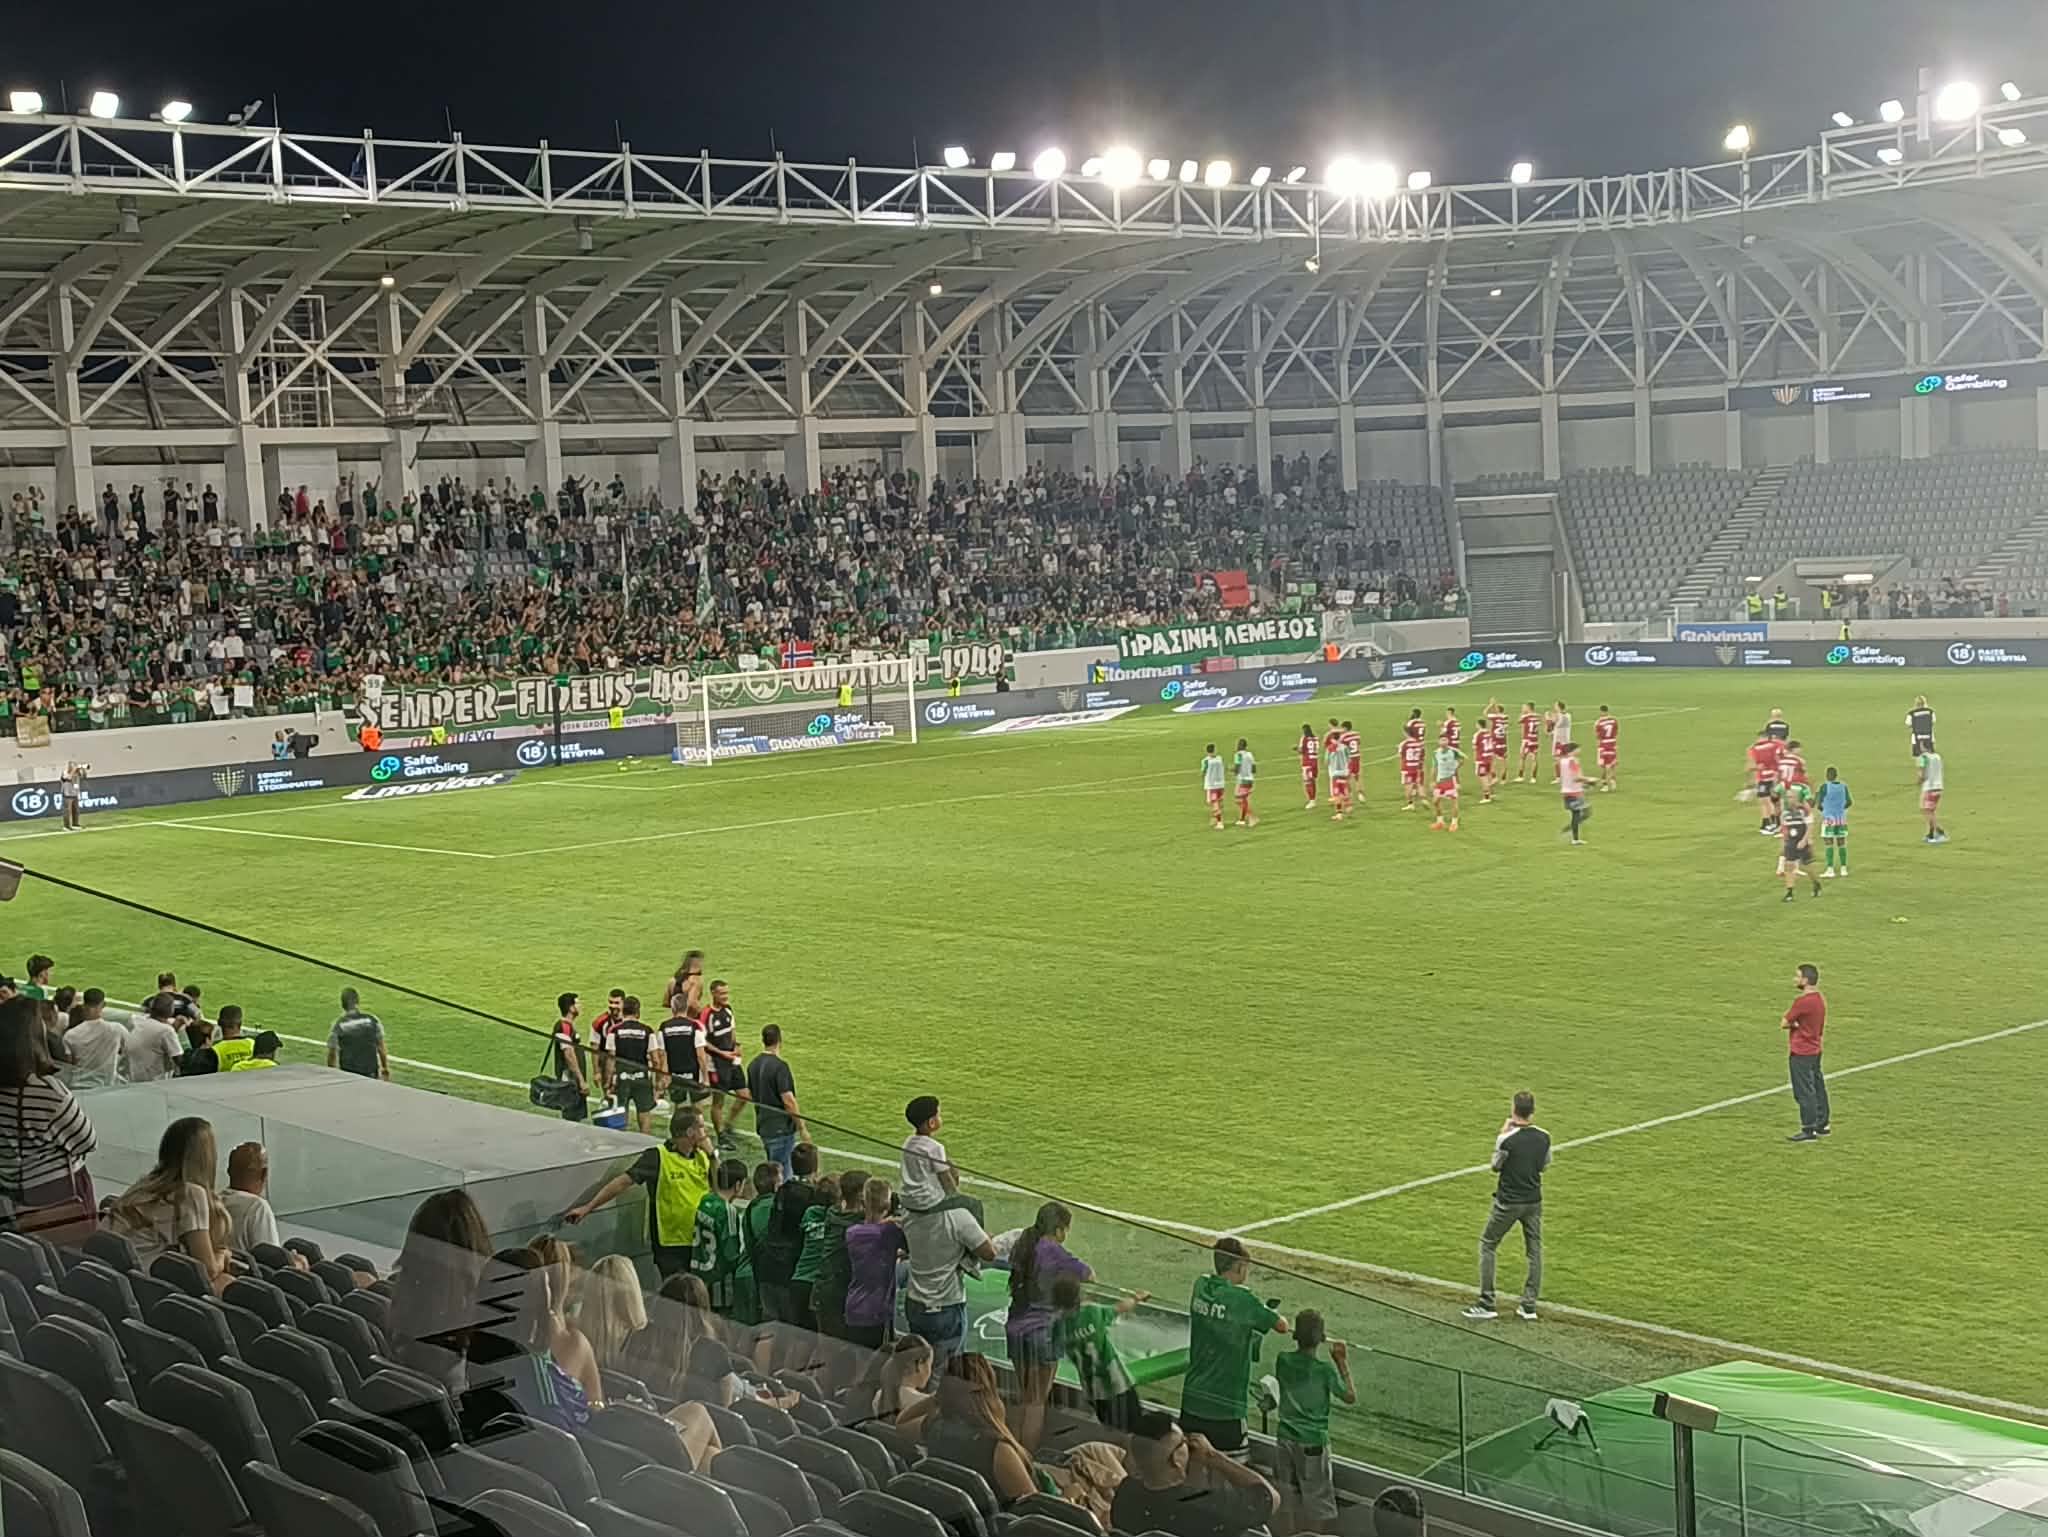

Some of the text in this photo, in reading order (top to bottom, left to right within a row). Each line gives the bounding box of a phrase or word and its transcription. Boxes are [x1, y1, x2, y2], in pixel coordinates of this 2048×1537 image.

[1945, 378, 2007, 392] Gambling
[1225, 617, 1317, 645] ΛΕΜΕΣΟΣ
[943, 644, 1003, 679] 1948
[1852, 655, 1905, 665] Gambling
[652, 668, 690, 702] 48
[403, 755, 439, 766] Safer
[404, 762, 468, 777] Gambling
